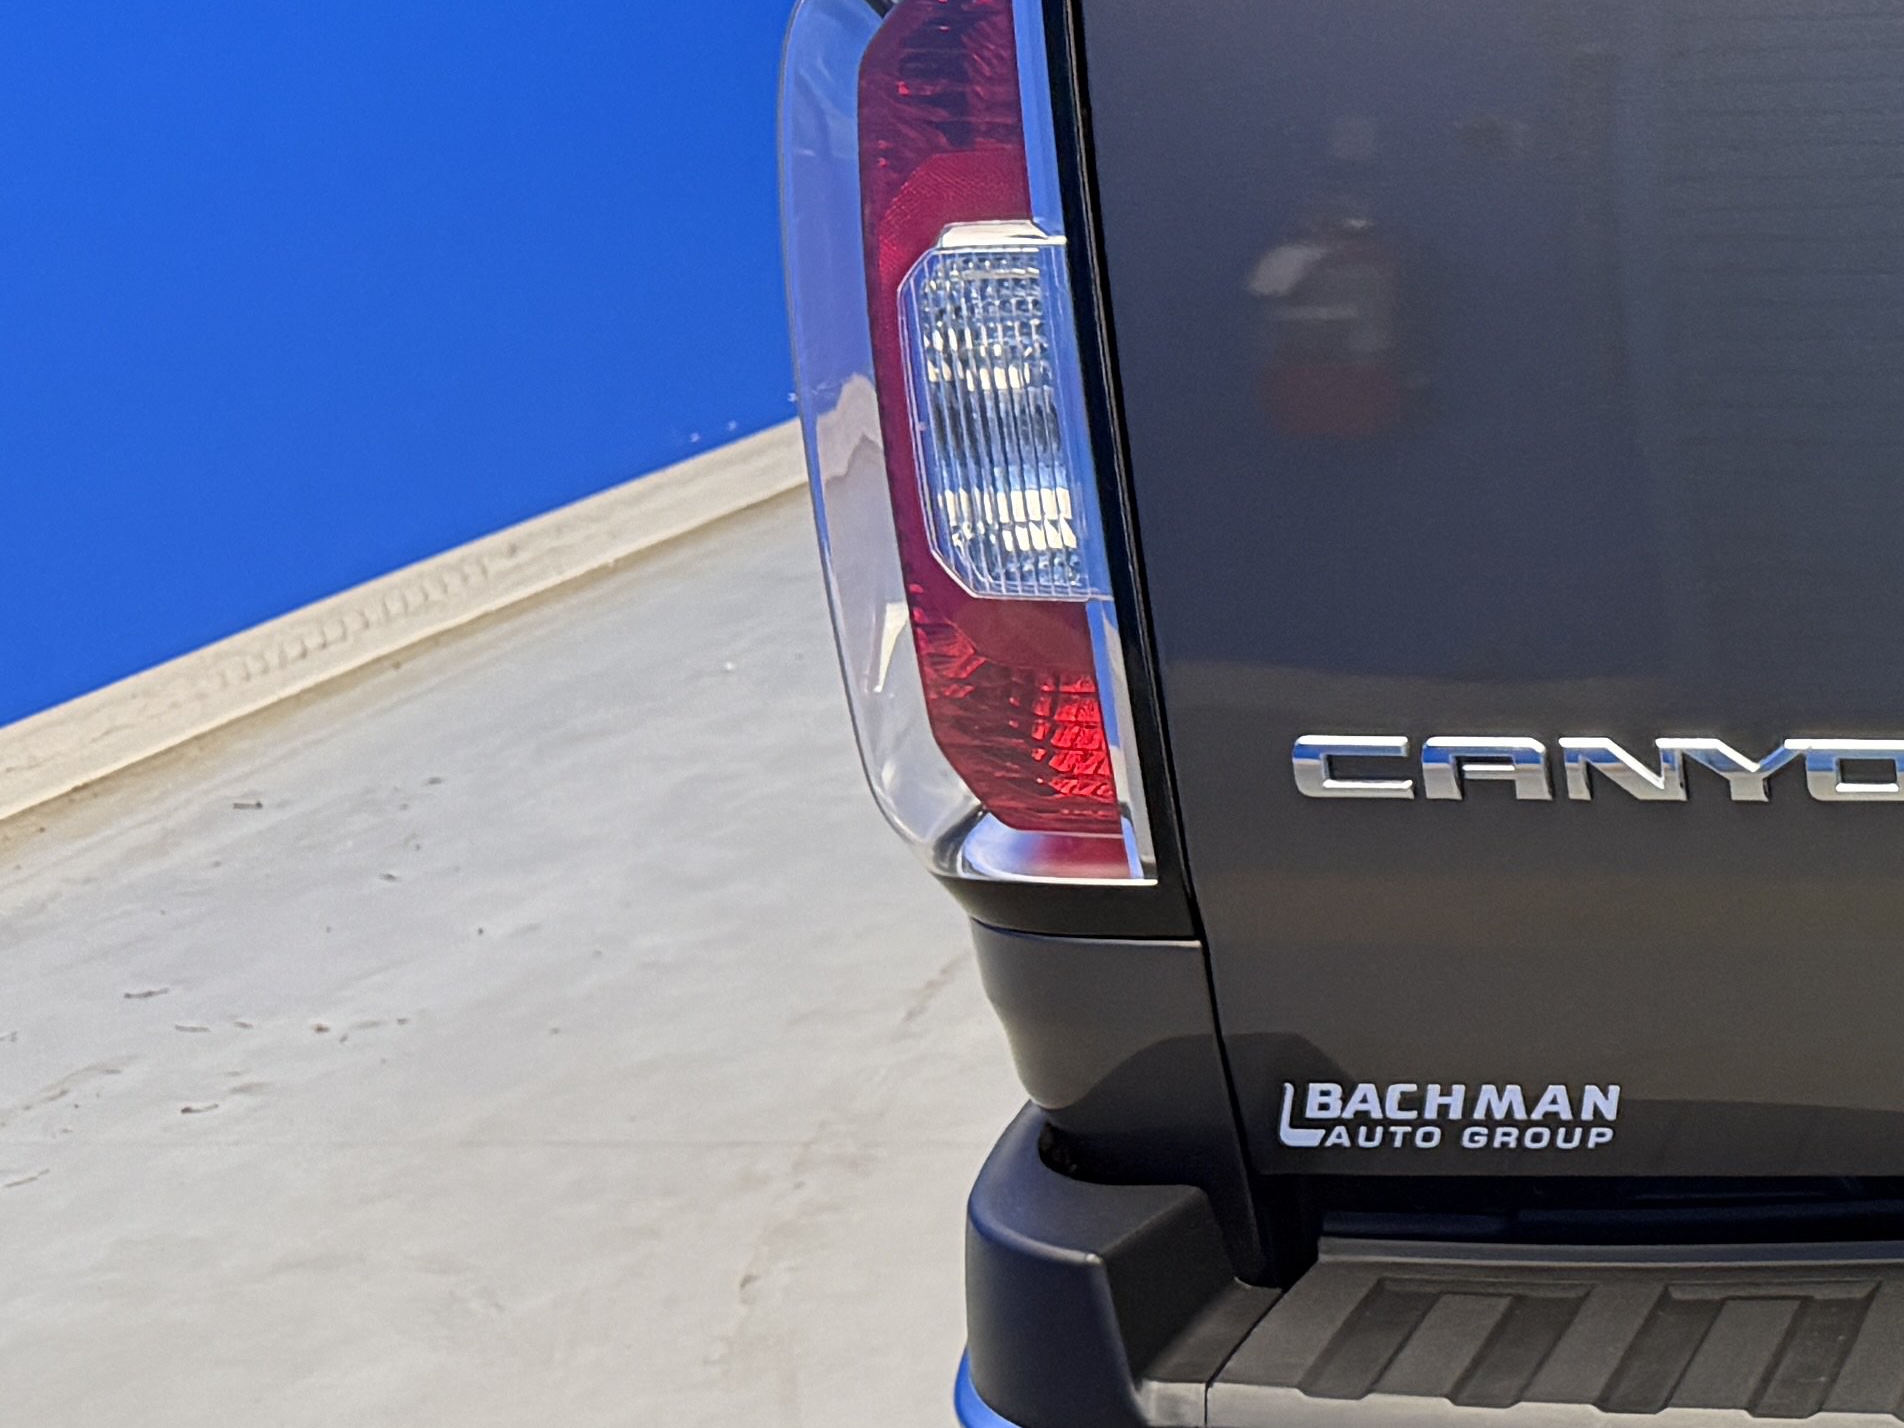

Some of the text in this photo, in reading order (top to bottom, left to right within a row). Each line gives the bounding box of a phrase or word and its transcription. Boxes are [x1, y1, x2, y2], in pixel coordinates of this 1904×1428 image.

[1305, 1082, 1621, 1121] BACHMAN
[1324, 1125, 1614, 1150] AUTO GROUP
